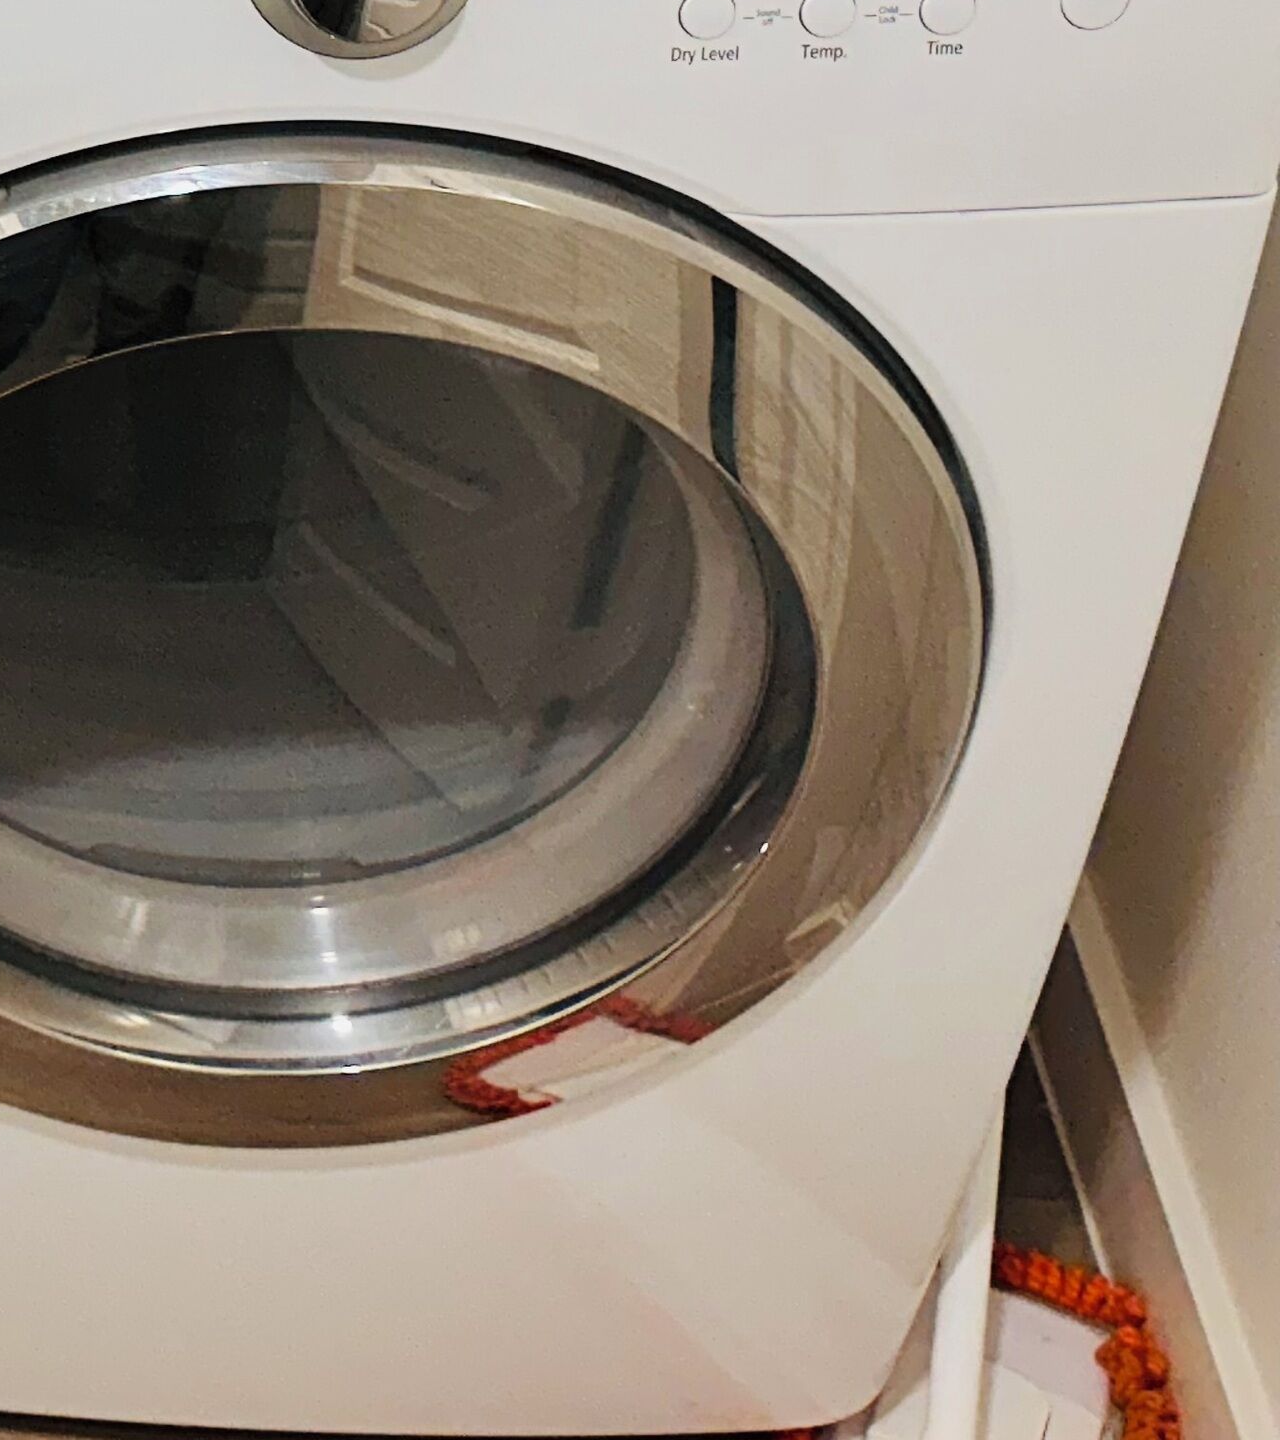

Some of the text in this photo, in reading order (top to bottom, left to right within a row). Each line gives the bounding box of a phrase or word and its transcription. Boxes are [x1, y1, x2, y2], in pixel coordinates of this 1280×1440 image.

[671, 46, 739, 65] Dry Level
[801, 44, 847, 62] Temp.
[927, 40, 963, 55] Time
